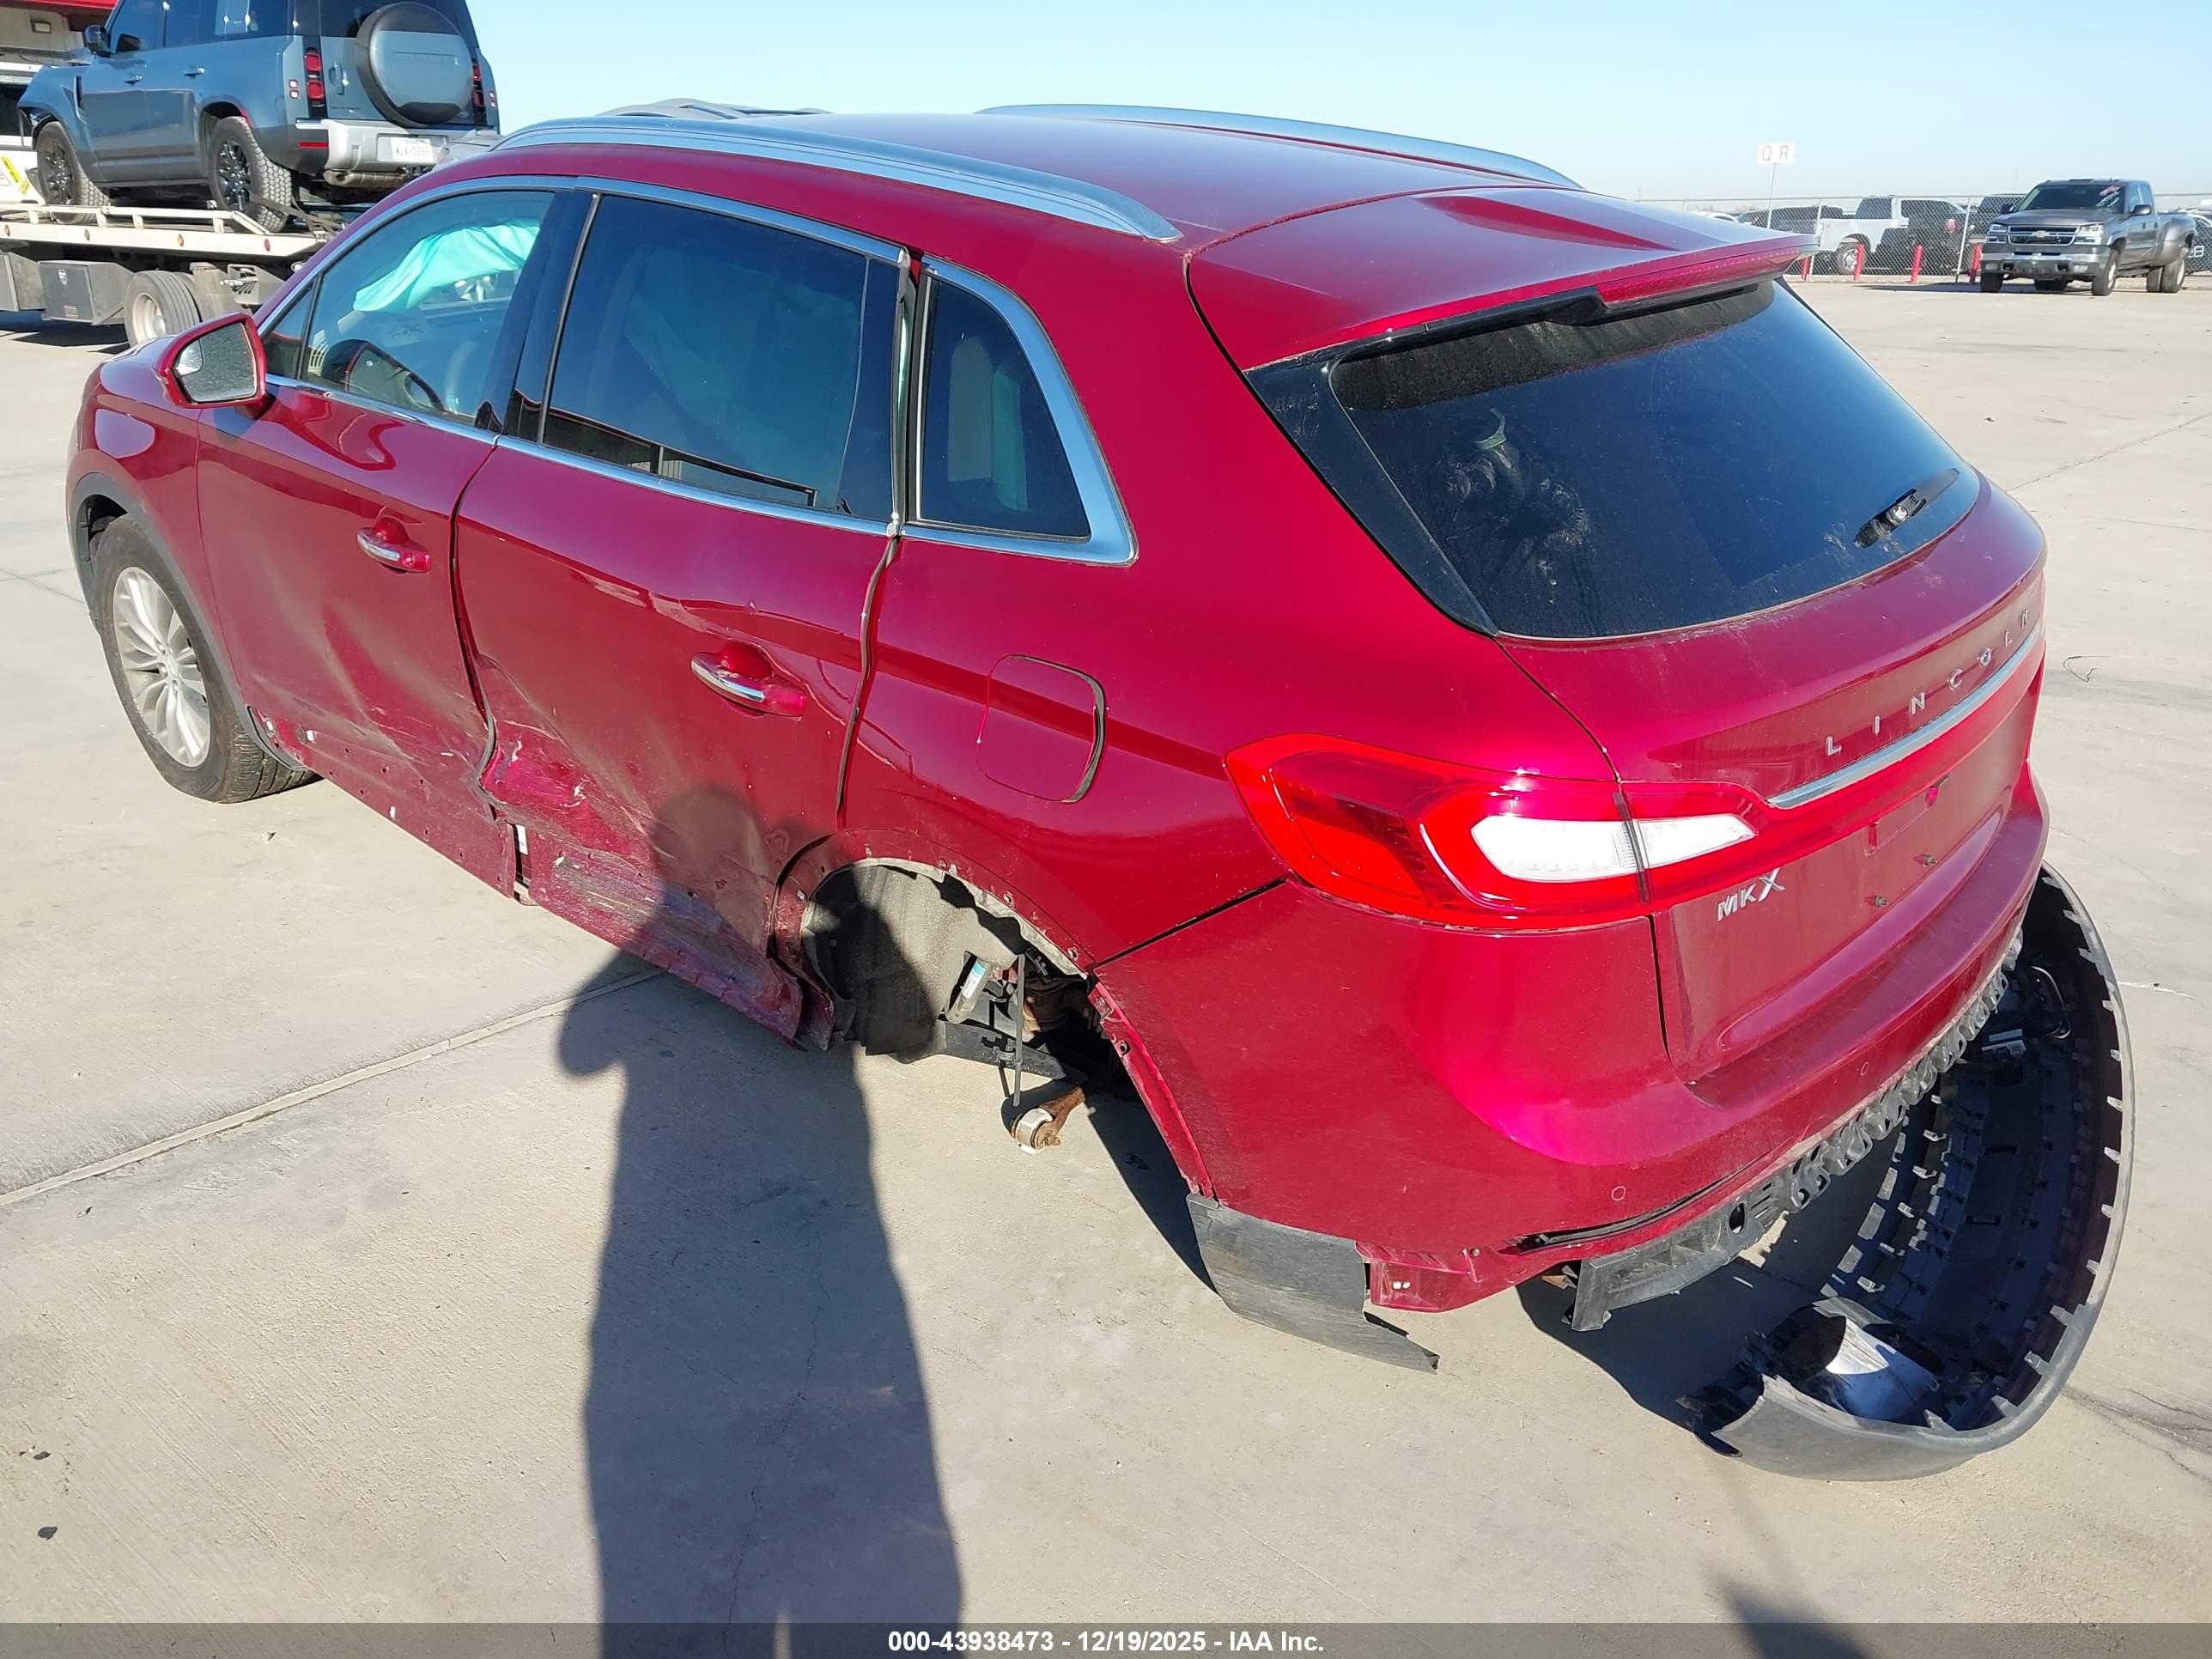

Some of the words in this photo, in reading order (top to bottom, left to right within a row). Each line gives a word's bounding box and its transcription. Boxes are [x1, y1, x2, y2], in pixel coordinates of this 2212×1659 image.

[1779, 145, 1790, 161] R
[1826, 608, 2029, 757] LINCOLN
[1717, 866, 1786, 922] MKX
